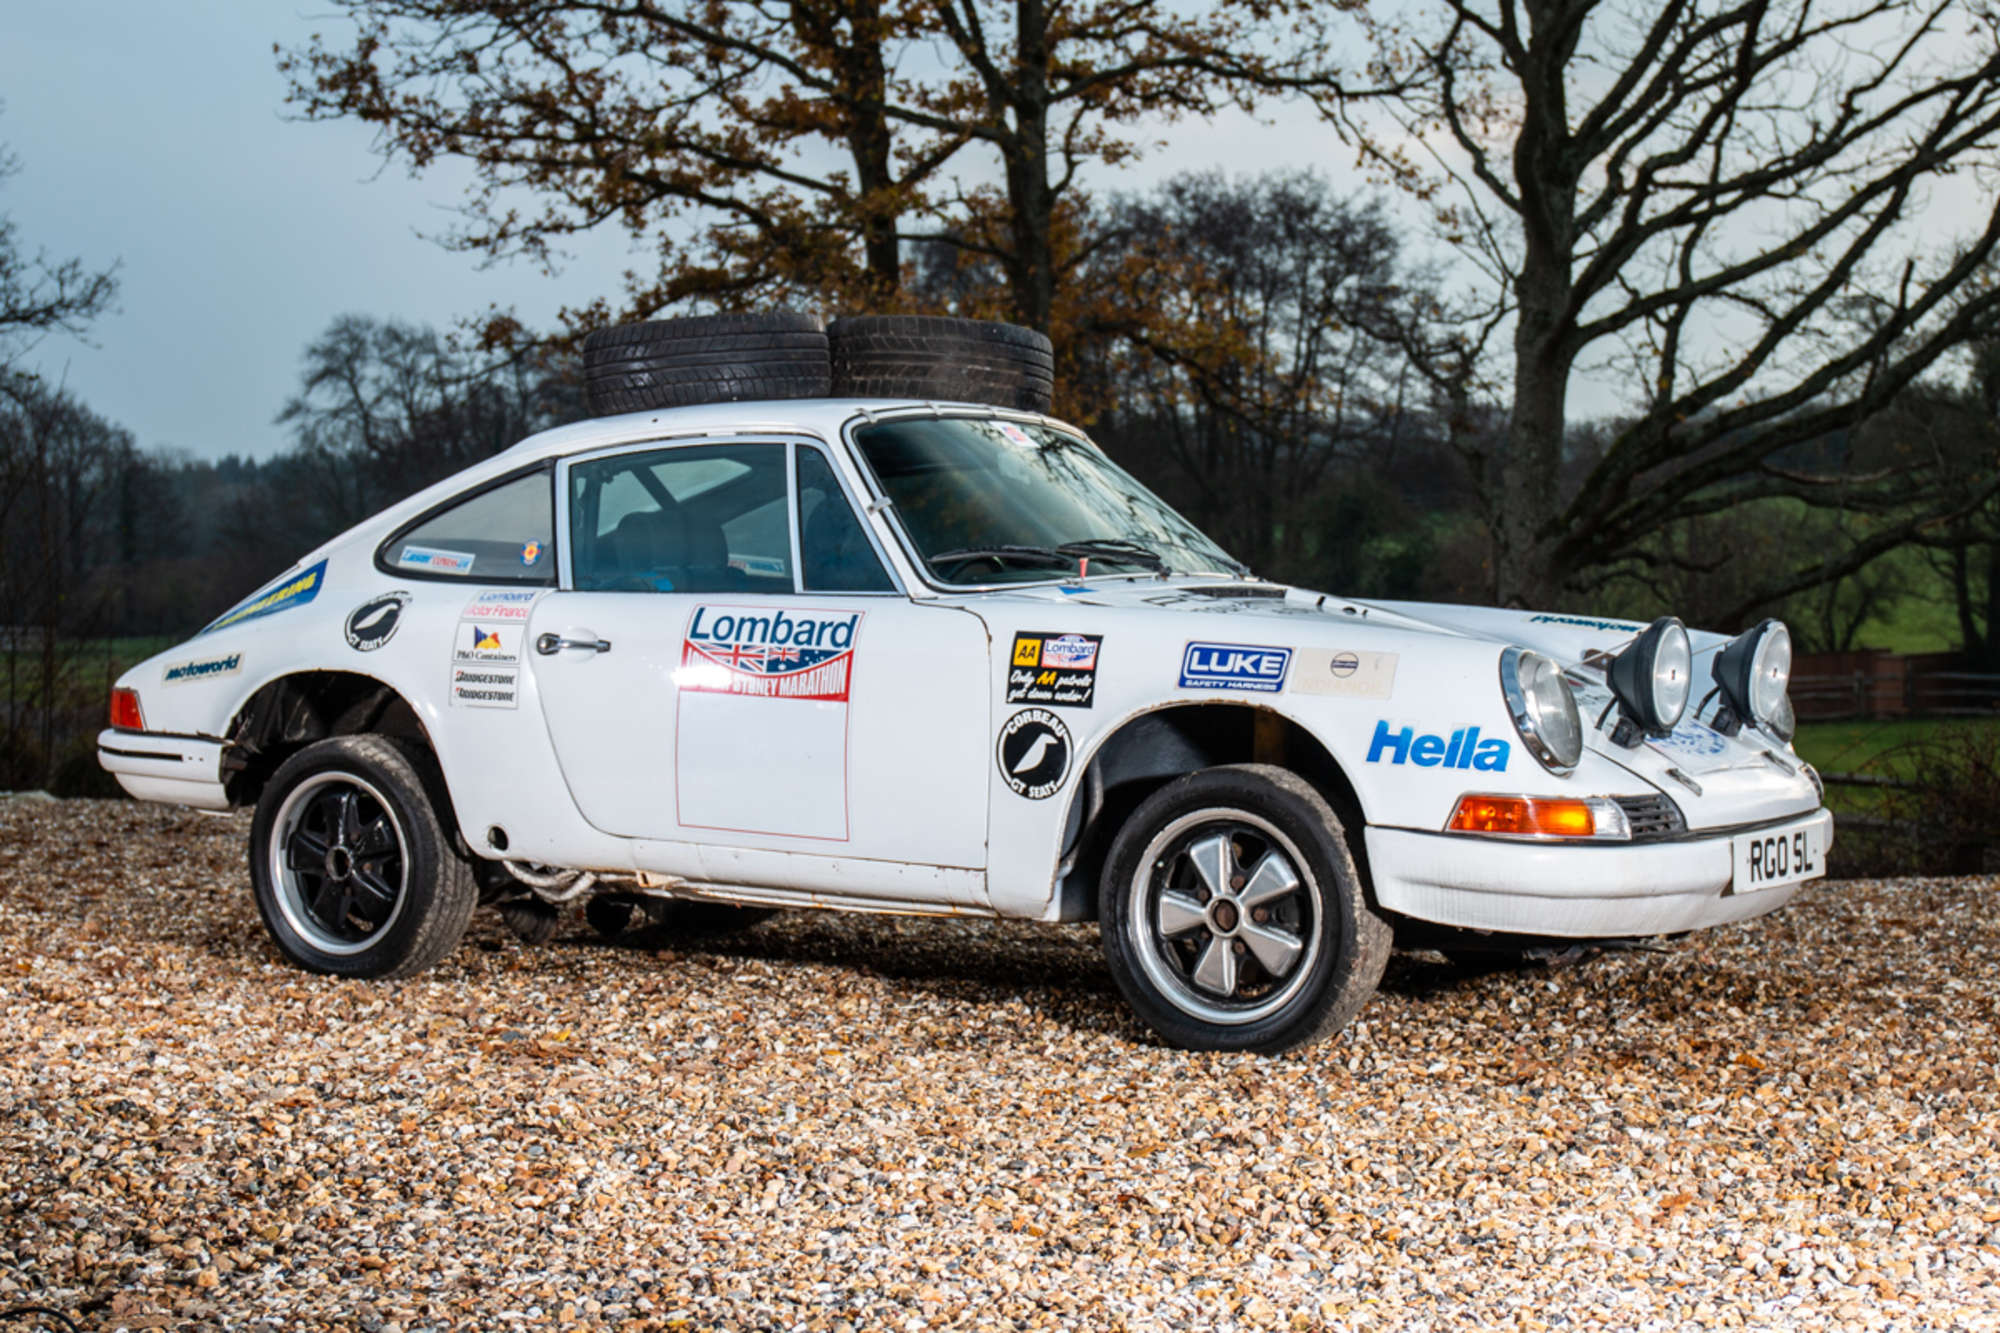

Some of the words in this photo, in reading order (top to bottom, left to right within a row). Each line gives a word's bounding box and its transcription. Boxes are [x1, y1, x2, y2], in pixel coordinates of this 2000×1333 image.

[689, 607, 859, 648] Lombard
[475, 650, 517, 662] Containers
[1017, 645, 1036, 659] AA
[1045, 642, 1096, 655] Lombard
[165, 653, 241, 681] motoworld
[1189, 650, 1283, 675] LUKE
[455, 670, 515, 685] BRIDGESTONE
[780, 654, 846, 697] MARATHON
[1010, 670, 1035, 689] Only
[1036, 671, 1057, 685] AA
[1055, 674, 1092, 690] patrols
[1185, 679, 1226, 688] SAFETY
[1227, 681, 1277, 691] HARNESS
[455, 687, 515, 702] BRIDGESTONE
[1007, 689, 1027, 702] get
[1027, 687, 1053, 699] down
[1006, 709, 1066, 738] CORBEAU
[1010, 778, 1027, 793] GT
[1028, 780, 1057, 799] SEATS
[1750, 835, 1789, 883] RGO
[1793, 830, 1813, 874] 5L
